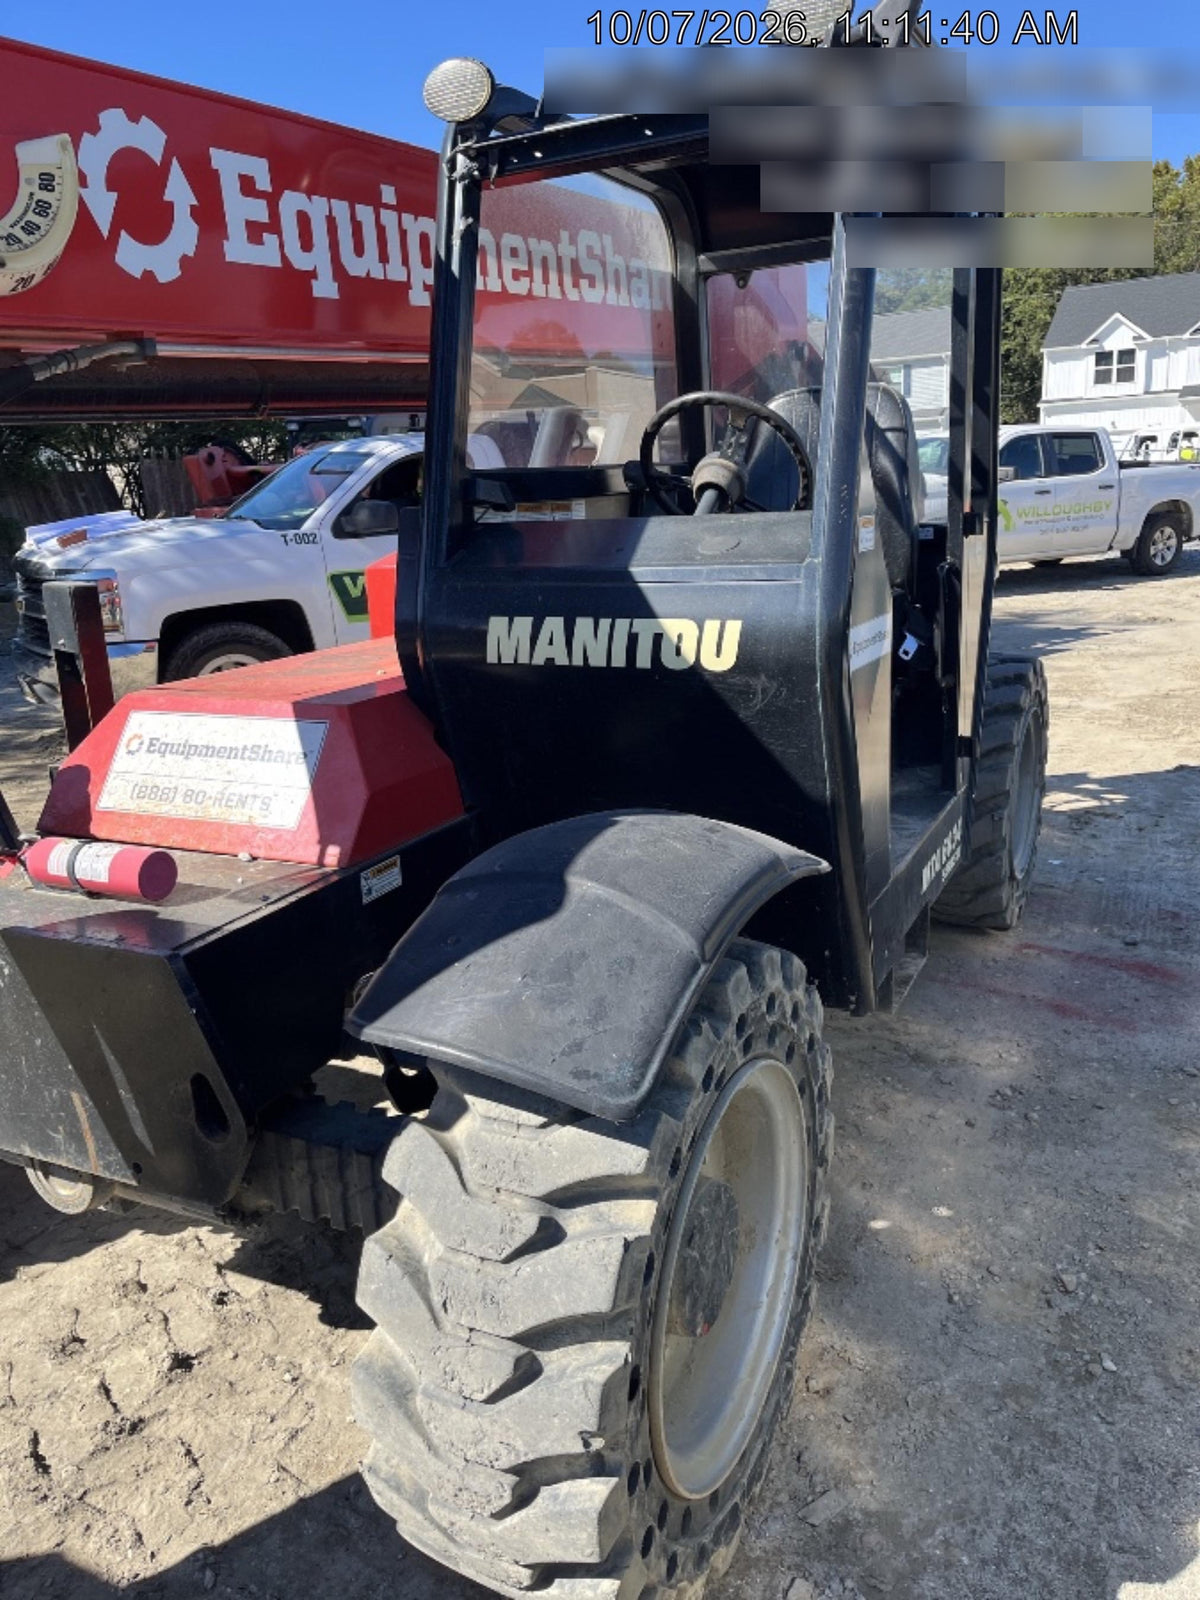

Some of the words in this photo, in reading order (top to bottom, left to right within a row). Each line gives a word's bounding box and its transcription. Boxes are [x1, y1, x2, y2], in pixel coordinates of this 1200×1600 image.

[38, 172, 55, 192] 80
[32, 199, 52, 218] 60
[20, 220, 41, 236] 40
[210, 146, 674, 312] EquipentShar
[1017, 501, 1112, 518] WILLOUGHBY
[280, 532, 319, 546] T-002
[486, 616, 743, 671] MANITOU
[145, 737, 309, 766] EquipmentShare
[129, 783, 179, 804] (888)
